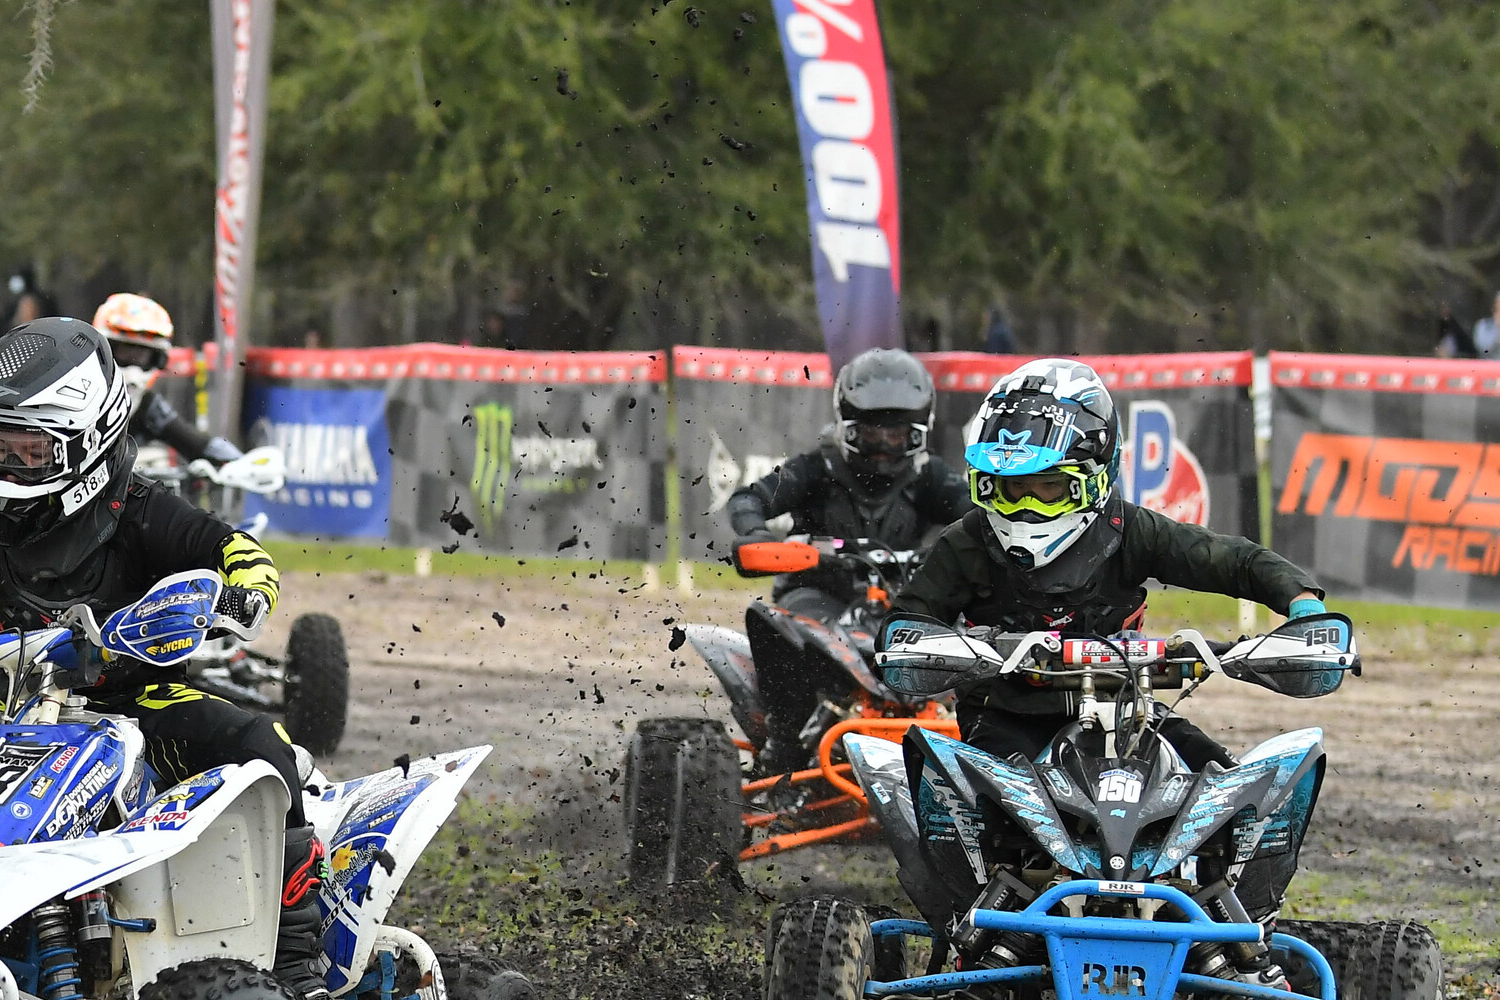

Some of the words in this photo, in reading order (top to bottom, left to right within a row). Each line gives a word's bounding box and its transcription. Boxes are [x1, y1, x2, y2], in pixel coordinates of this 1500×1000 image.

[74, 476, 98, 503] 518
[160, 637, 193, 654] CYCRA
[889, 628, 924, 645] 150
[1304, 628, 1340, 647] 150
[52, 746, 78, 772] KENDA
[1098, 775, 1142, 803] 150
[126, 812, 188, 830] KENDA
[1108, 882, 1136, 891] RJR
[1081, 962, 1147, 997] RJR
